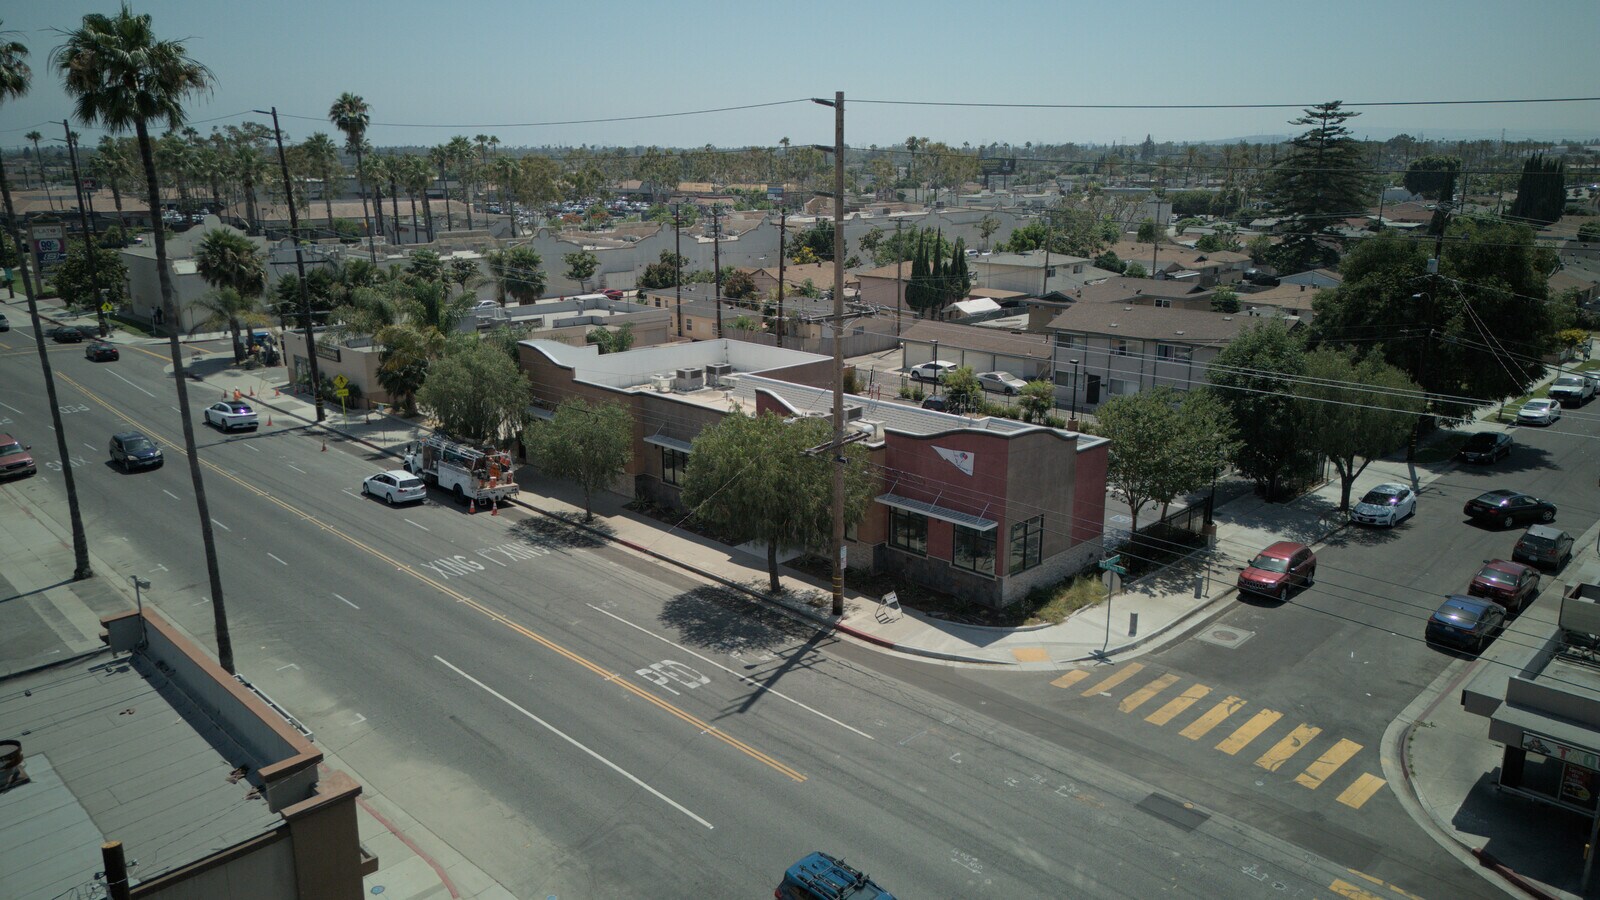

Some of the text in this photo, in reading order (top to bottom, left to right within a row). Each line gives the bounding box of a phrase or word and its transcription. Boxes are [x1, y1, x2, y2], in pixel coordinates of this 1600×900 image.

[58, 404, 90, 414] PED
[489, 541, 550, 561] XING
[420, 555, 485, 579] XING
[635, 659, 711, 695] PED
